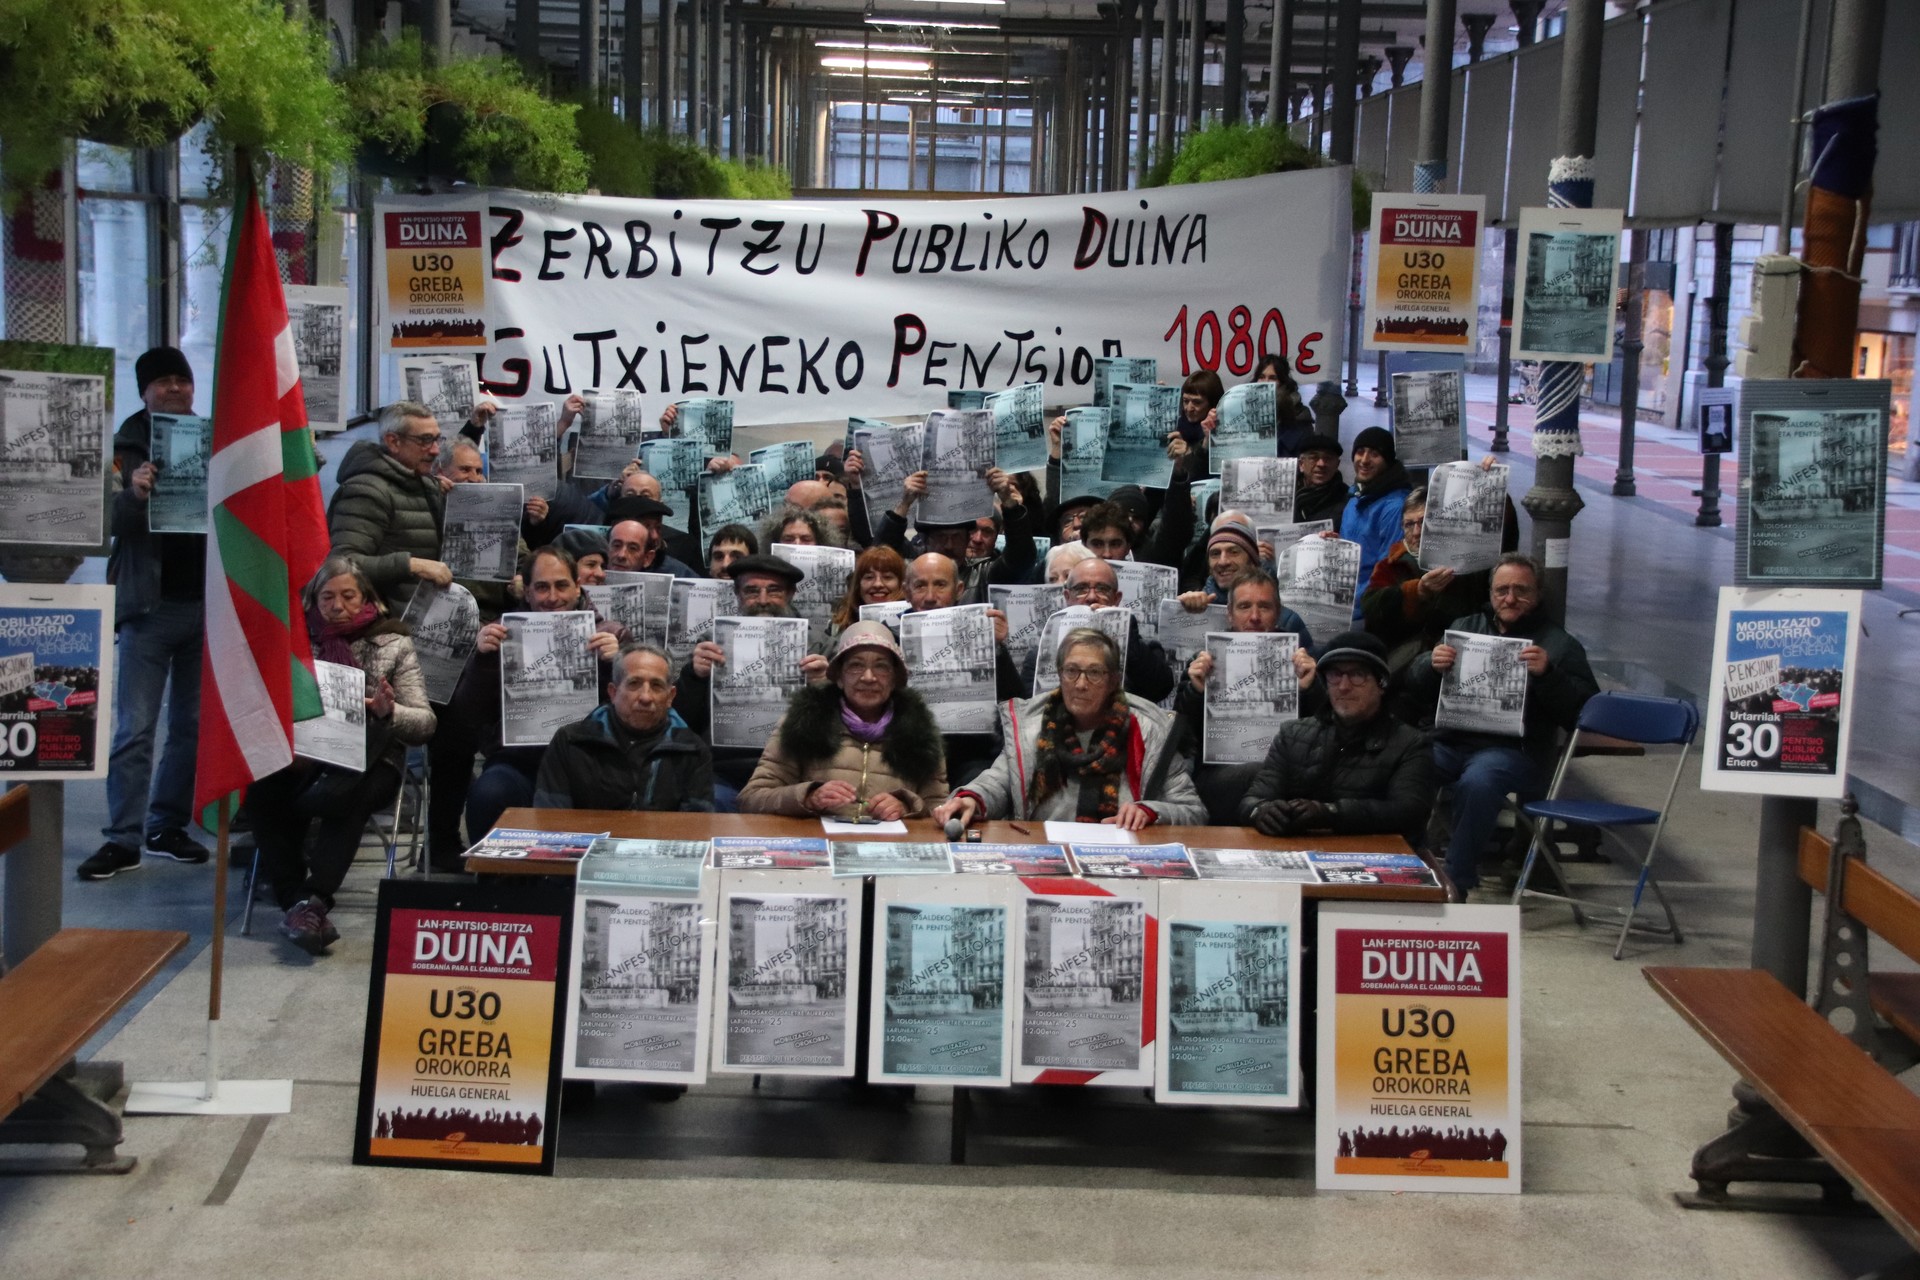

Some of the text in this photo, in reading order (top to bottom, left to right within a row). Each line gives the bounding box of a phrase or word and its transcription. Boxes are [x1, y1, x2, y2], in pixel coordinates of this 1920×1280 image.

[400, 224, 467, 240] DUINA
[1395, 221, 1461, 238] DUINA
[413, 255, 453, 272] U30
[1404, 252, 1445, 269] U30
[410, 277, 463, 292] GREBA
[1398, 274, 1451, 290] GREBA
[410, 293, 464, 302] OROKORRA
[1397, 290, 1450, 300] OROKORRA
[0, 407, 91, 456] ANIFESTAZIOA
[1762, 441, 1866, 500] MANIFESTAZIOA
[0, 614, 75, 628] OBILIZAZIO
[1736, 617, 1820, 632] MOBILIZAZIO
[0, 625, 66, 638] ROKORRA
[1736, 628, 1811, 641] OROKORRA
[1783, 646, 1838, 657] GENERAL
[1214, 658, 1289, 702] MANIFESTAZIOA
[1730, 711, 1780, 722] Urtarrilak
[1726, 722, 1779, 758] 30
[1726, 757, 1758, 767] Enero
[417, 919, 533, 934] LAN-PENTSIO-BIZITZA
[415, 932, 532, 965] DUINA
[1362, 938, 1480, 950] LAN-PENTSIO-BIZITZA
[592, 931, 690, 988] MANIFESTAZIOA
[739, 926, 835, 985] MANIFESTAZIOA
[1035, 930, 1131, 987] MANIFESTAZIOA
[412, 962, 450, 971] SOBERANÍA
[1362, 951, 1482, 983] DUINA
[1180, 954, 1276, 1012] MANIFESTAZIOA
[1360, 982, 1399, 991] SOBERANÍA
[430, 989, 501, 1020] U30
[620, 1020, 633, 1029] 25
[769, 1017, 782, 1025] 25
[1064, 1019, 1077, 1028] 25
[1382, 1008, 1455, 1038] U30
[418, 1028, 512, 1059] GREBA
[774, 1030, 812, 1044] MOBILIZAZIO
[1211, 1044, 1223, 1052] 25
[415, 1058, 511, 1078] OROKORRA
[1216, 1058, 1254, 1071] MOBILIZAZIO
[1373, 1047, 1471, 1076] GREBA
[411, 1085, 511, 1100] HUELGA GENERAL
[1372, 1076, 1471, 1095] OROKORRA
[1370, 1104, 1473, 1118] HUELGA GENERAL
